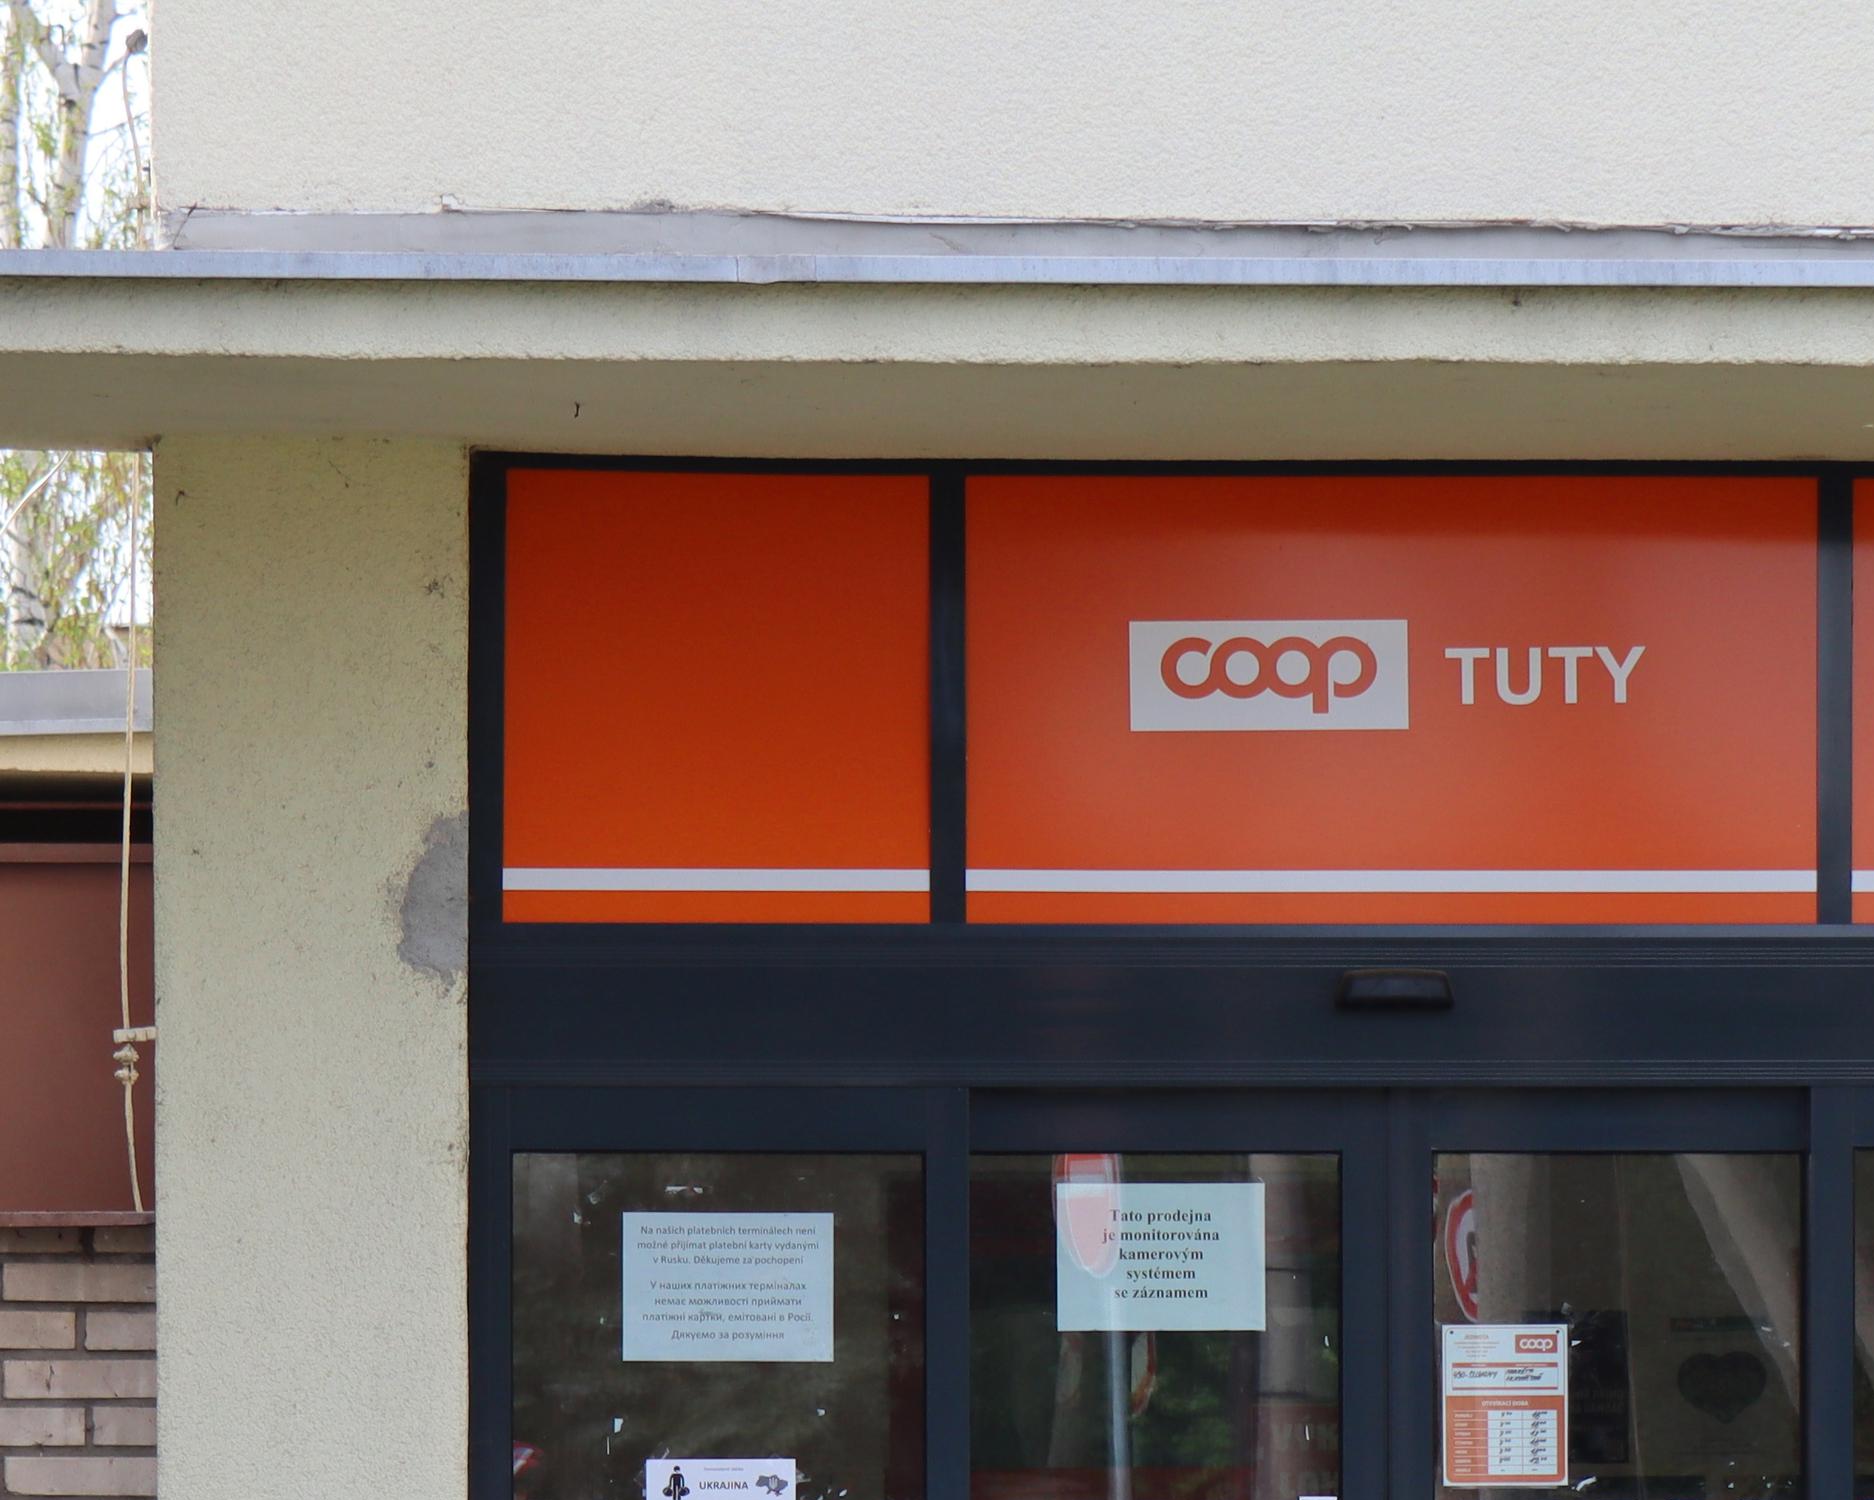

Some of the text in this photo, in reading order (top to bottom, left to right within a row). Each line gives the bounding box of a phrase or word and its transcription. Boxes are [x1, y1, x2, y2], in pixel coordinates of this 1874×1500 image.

[1160, 635, 1377, 714] coop
[1444, 646, 1646, 706] TUTY
[1110, 1208, 1213, 1226] Tato prodejna
[640, 1225, 816, 1236] Na našich platebních terminálech není
[1101, 1227, 1221, 1245] je monitorována
[1119, 1248, 1204, 1264] kamerovým
[1126, 1267, 1196, 1283] systémem
[1114, 1286, 1208, 1300] se záznamem
[1519, 1338, 1553, 1352] coop
[698, 1481, 749, 1490] UKRAJINA
